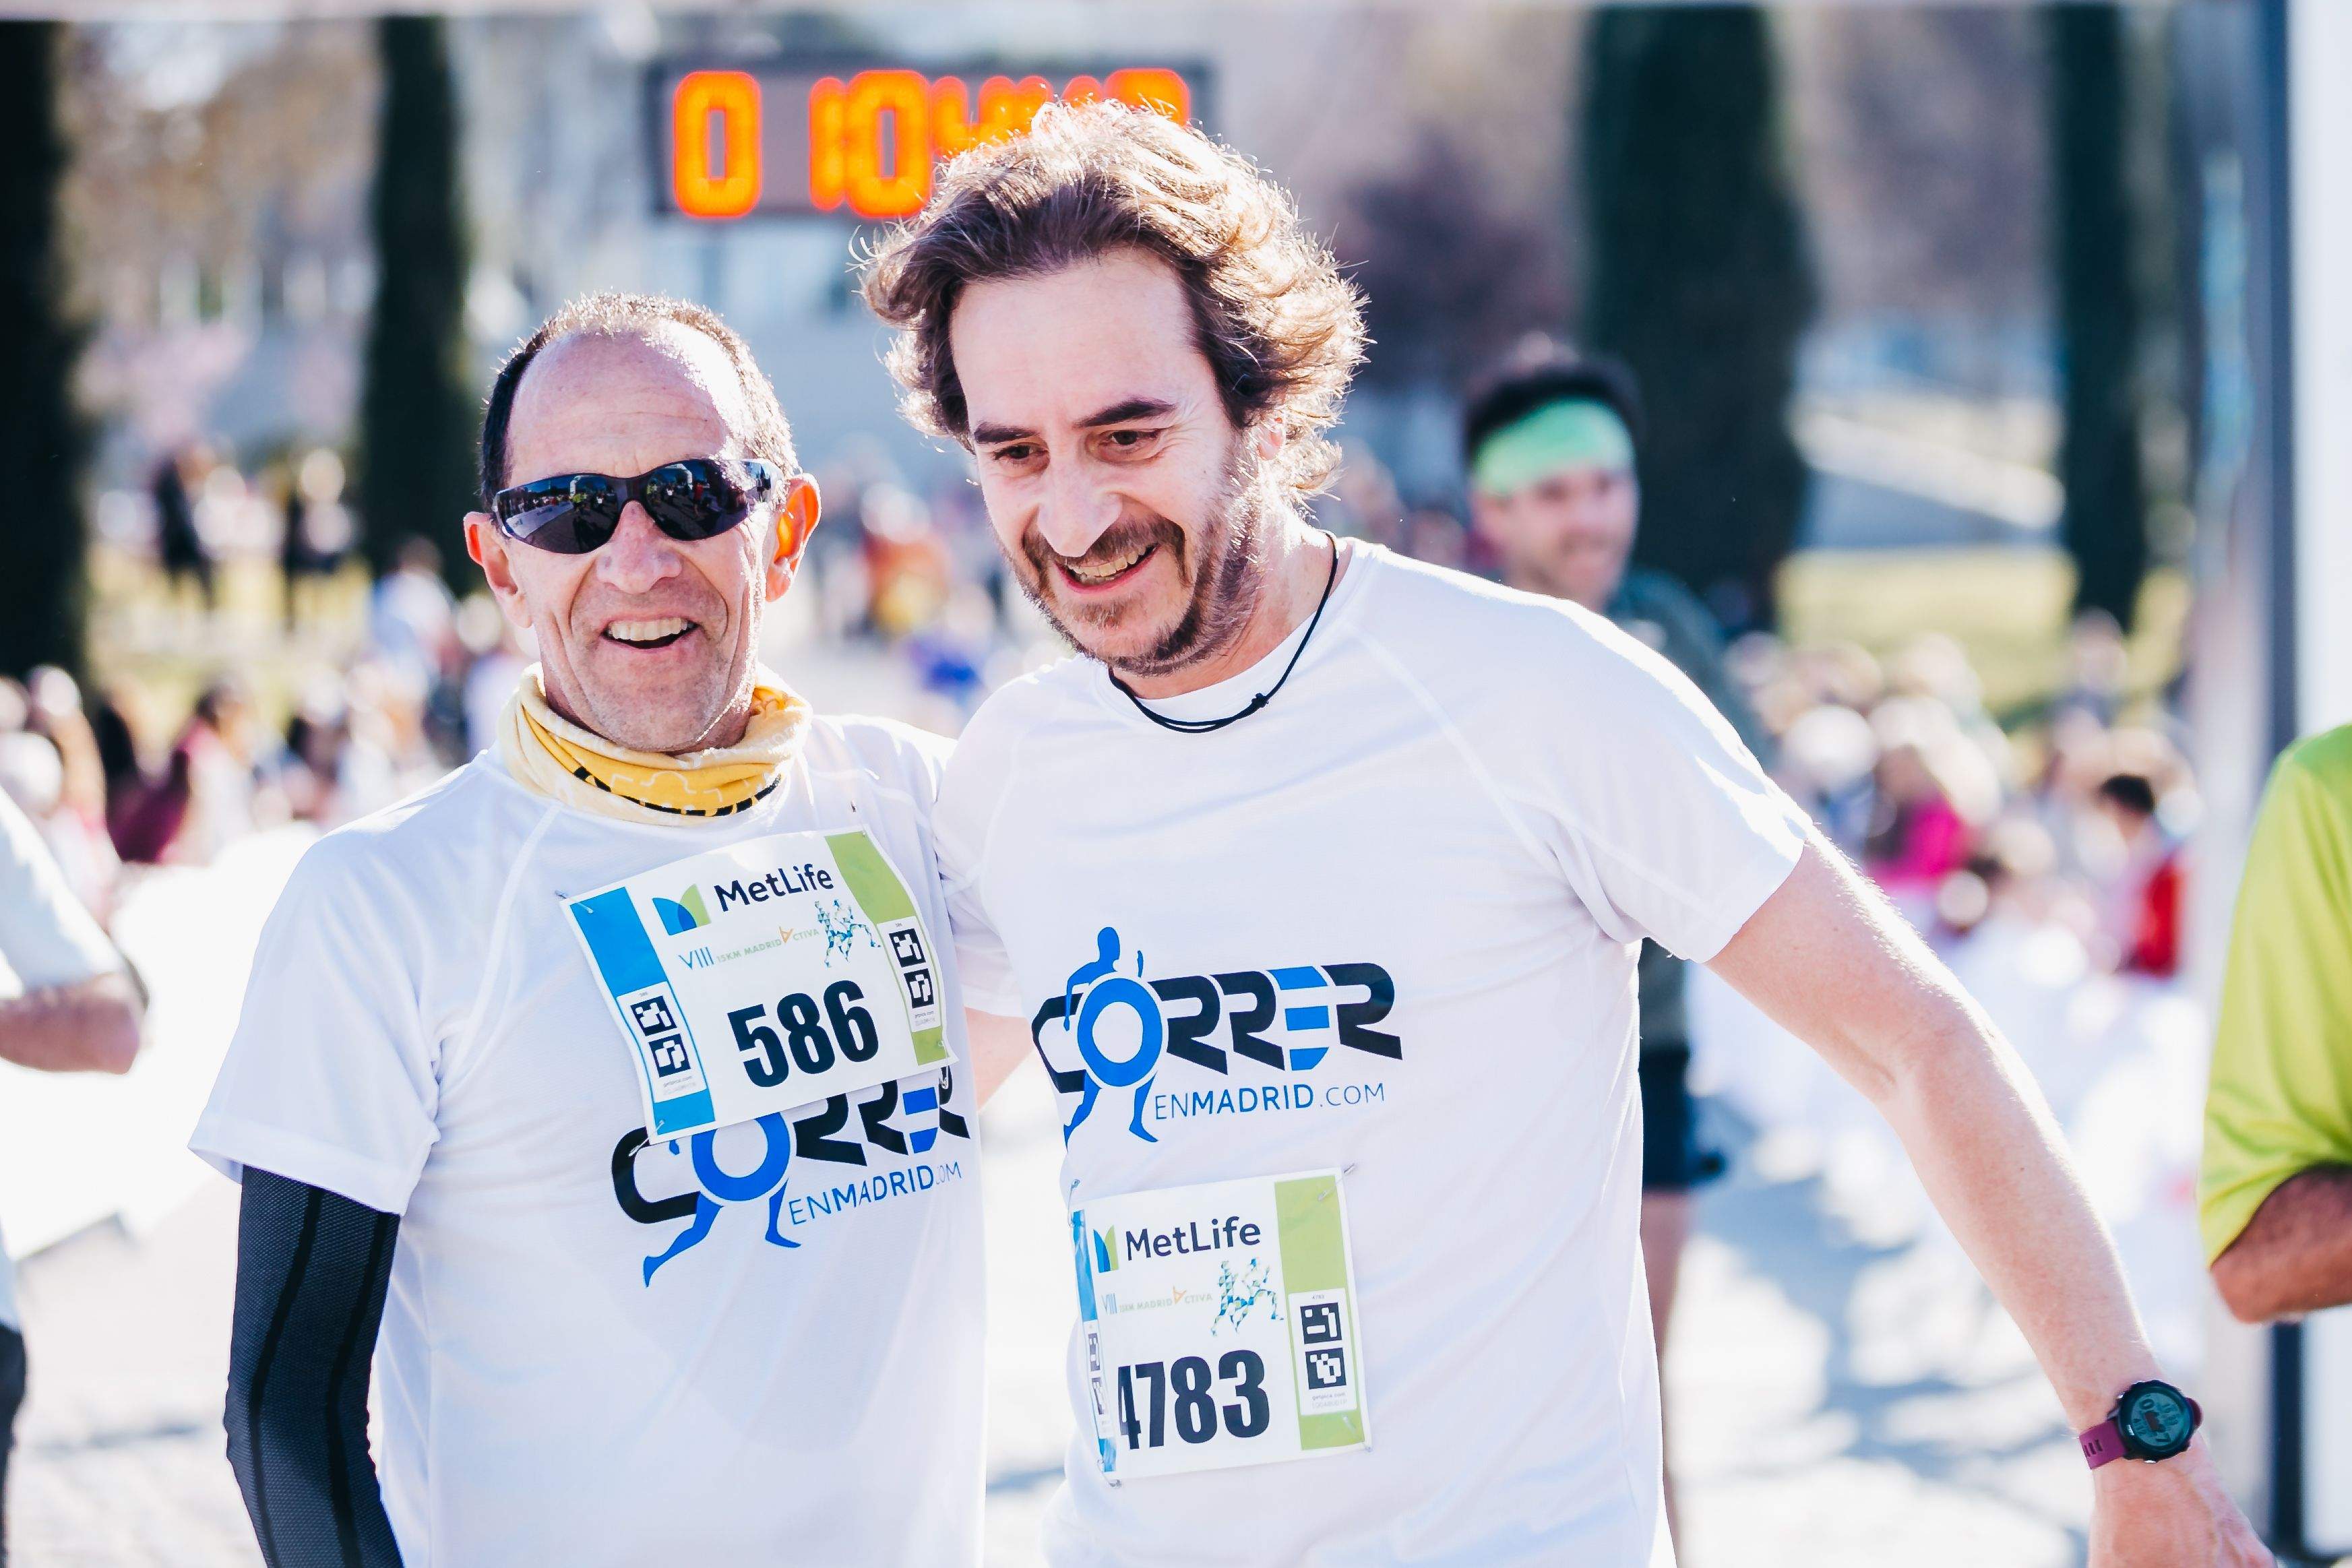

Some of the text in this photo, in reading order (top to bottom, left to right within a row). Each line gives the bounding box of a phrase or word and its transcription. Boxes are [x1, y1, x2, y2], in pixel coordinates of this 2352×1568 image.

[713, 863, 834, 912] MetLife
[678, 946, 714, 970] VIII
[716, 951, 741, 964] 15KM
[727, 980, 879, 1088] 586
[1031, 962, 1402, 1094] CORRER
[1155, 1082, 1385, 1120] ENMADRID.COM
[1125, 1216, 1262, 1261] MetLife
[1117, 1349, 1270, 1450] 4783
